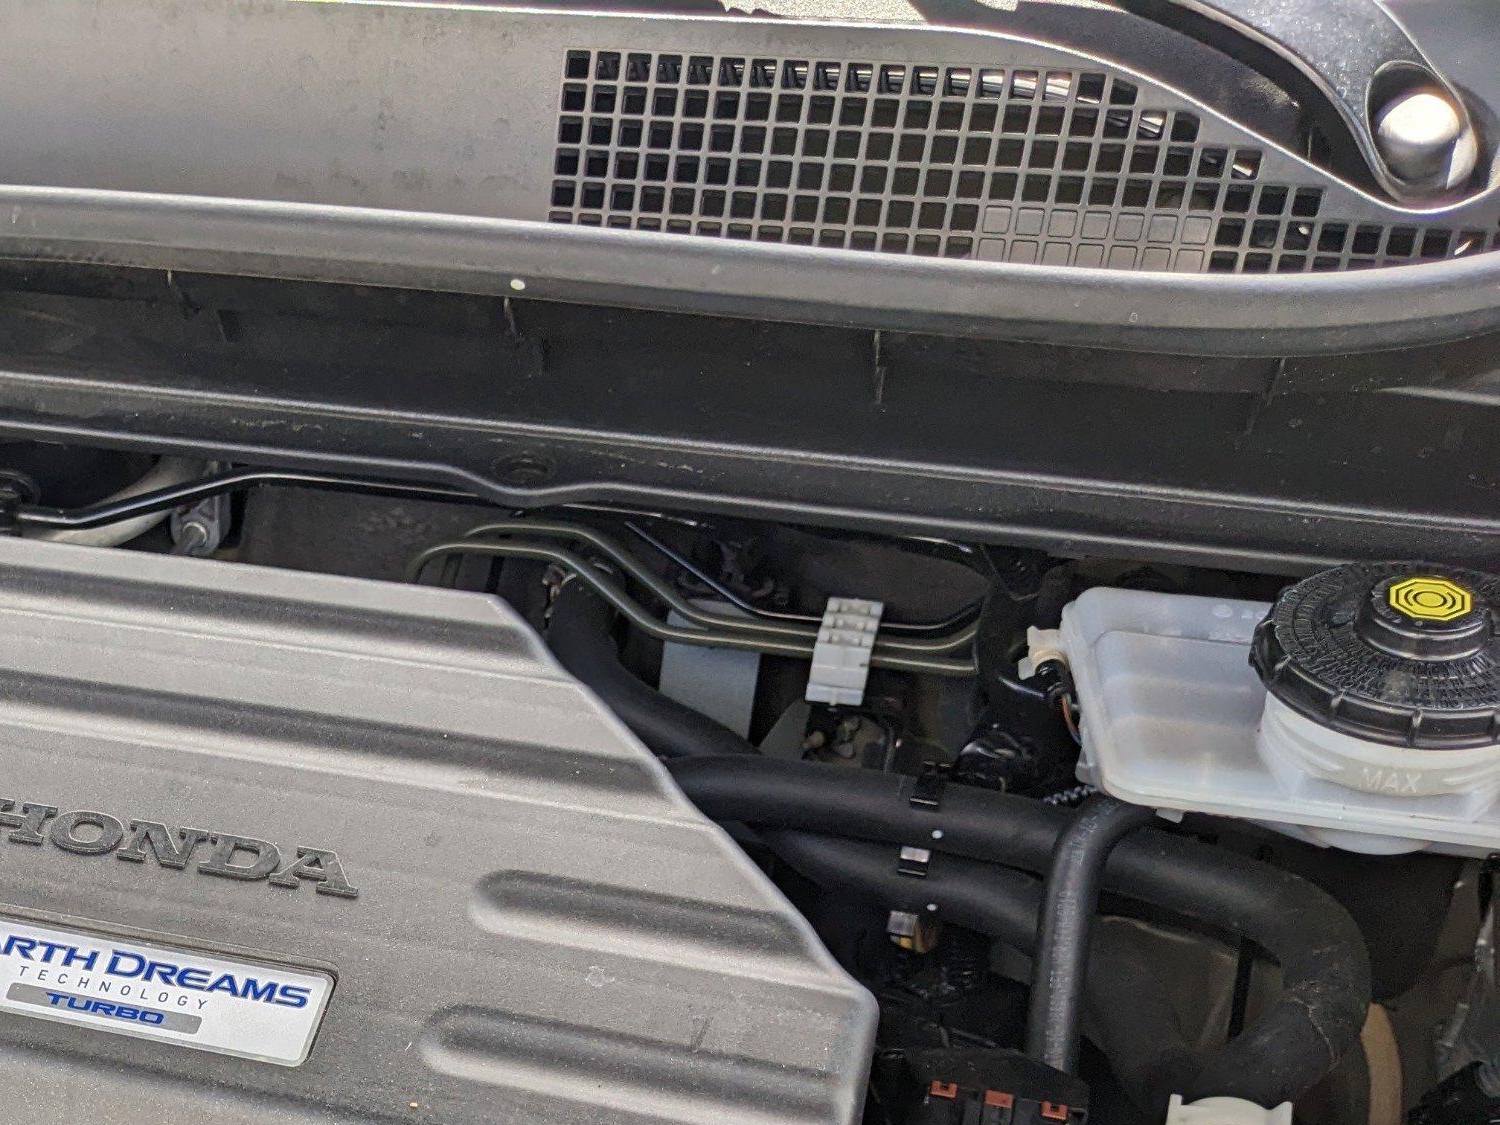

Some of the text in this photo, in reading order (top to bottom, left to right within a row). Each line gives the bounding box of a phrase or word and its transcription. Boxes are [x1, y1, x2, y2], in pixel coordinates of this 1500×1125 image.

[1362, 767, 1422, 793] MAX
[18, 965, 209, 1010] TECHNOLOGY
[105, 949, 313, 1010] DREAMS
[44, 991, 165, 1026] TURBO
